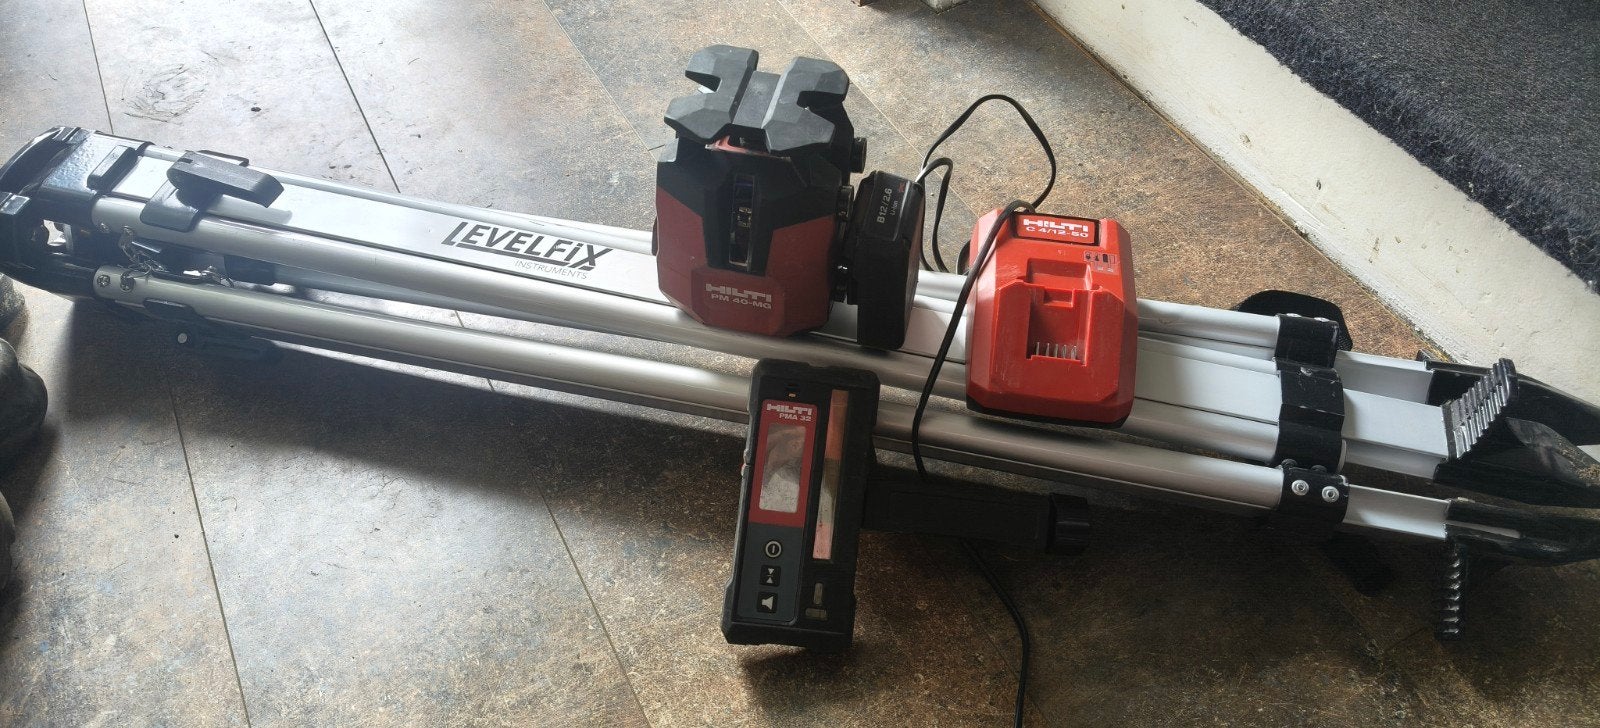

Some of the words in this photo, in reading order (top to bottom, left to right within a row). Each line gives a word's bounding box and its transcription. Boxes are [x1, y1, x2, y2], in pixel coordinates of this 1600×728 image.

[1023, 219, 1089, 232] HILTI
[1039, 227, 1089, 238] 4/12-50
[514, 259, 588, 280] INSTRUMENTS
[705, 283, 772, 303] HILTI
[711, 293, 730, 302] PM
[732, 298, 772, 309] 40-MG
[766, 403, 813, 415] HILTI
[779, 412, 798, 421] PMA
